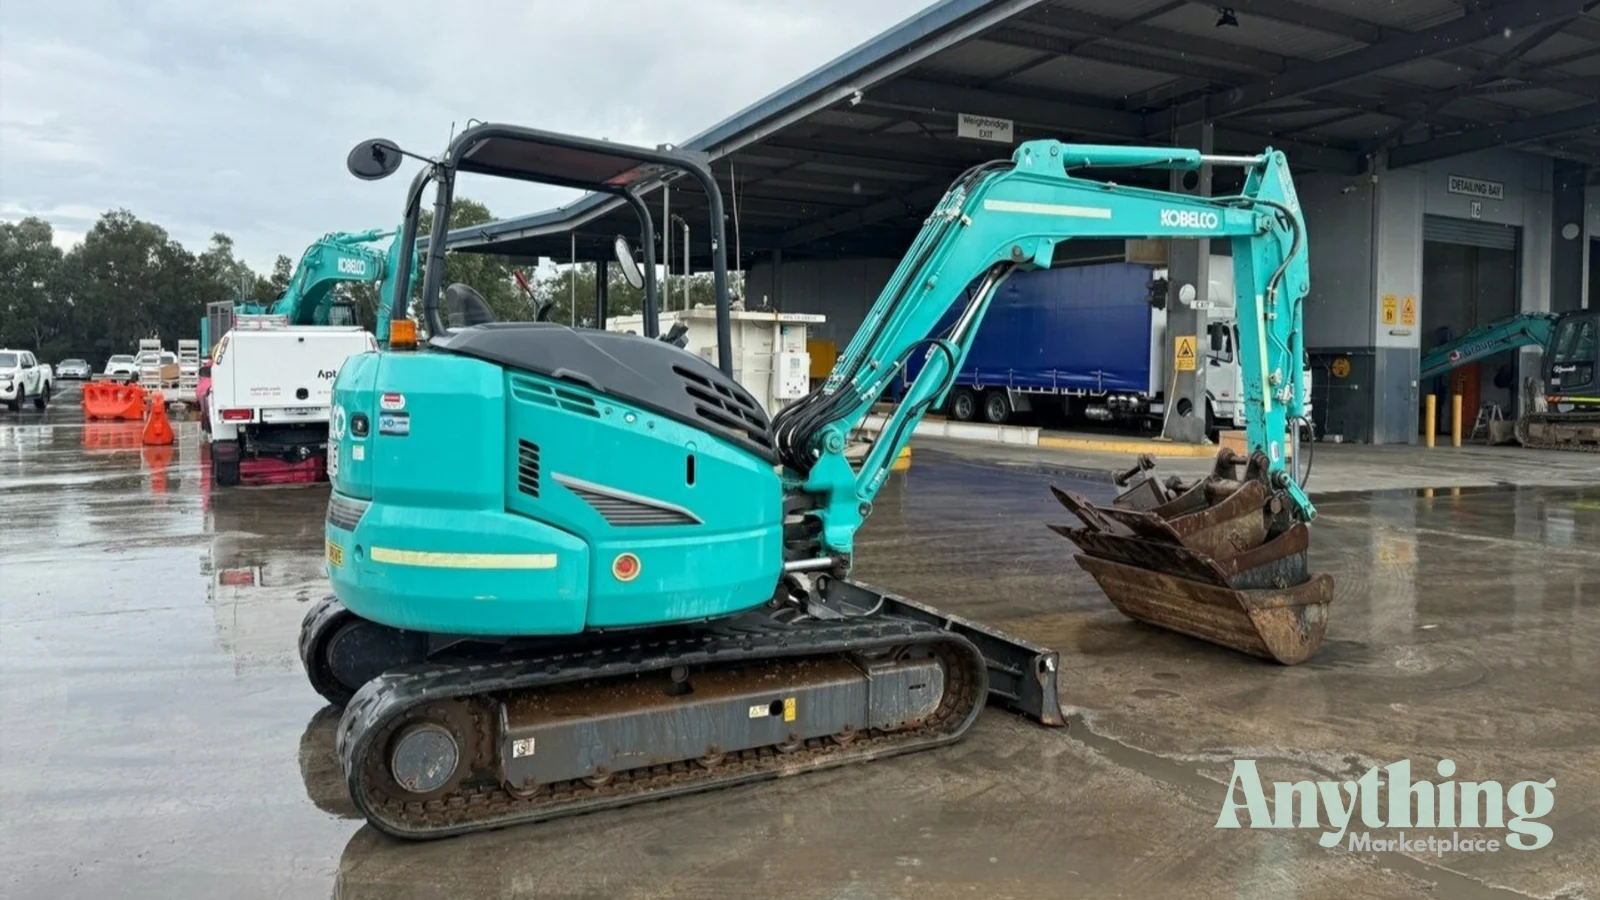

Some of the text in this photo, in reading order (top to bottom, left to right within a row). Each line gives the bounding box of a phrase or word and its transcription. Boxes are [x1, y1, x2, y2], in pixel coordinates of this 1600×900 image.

[962, 115, 1010, 131] Weighbridge
[979, 130, 993, 139] EXIT
[1451, 178, 1502, 197] DETAILING BAY
[1160, 208, 1219, 229] KOBELCO
[1472, 204, 1480, 217] 16
[337, 256, 366, 275] KOBELCO
